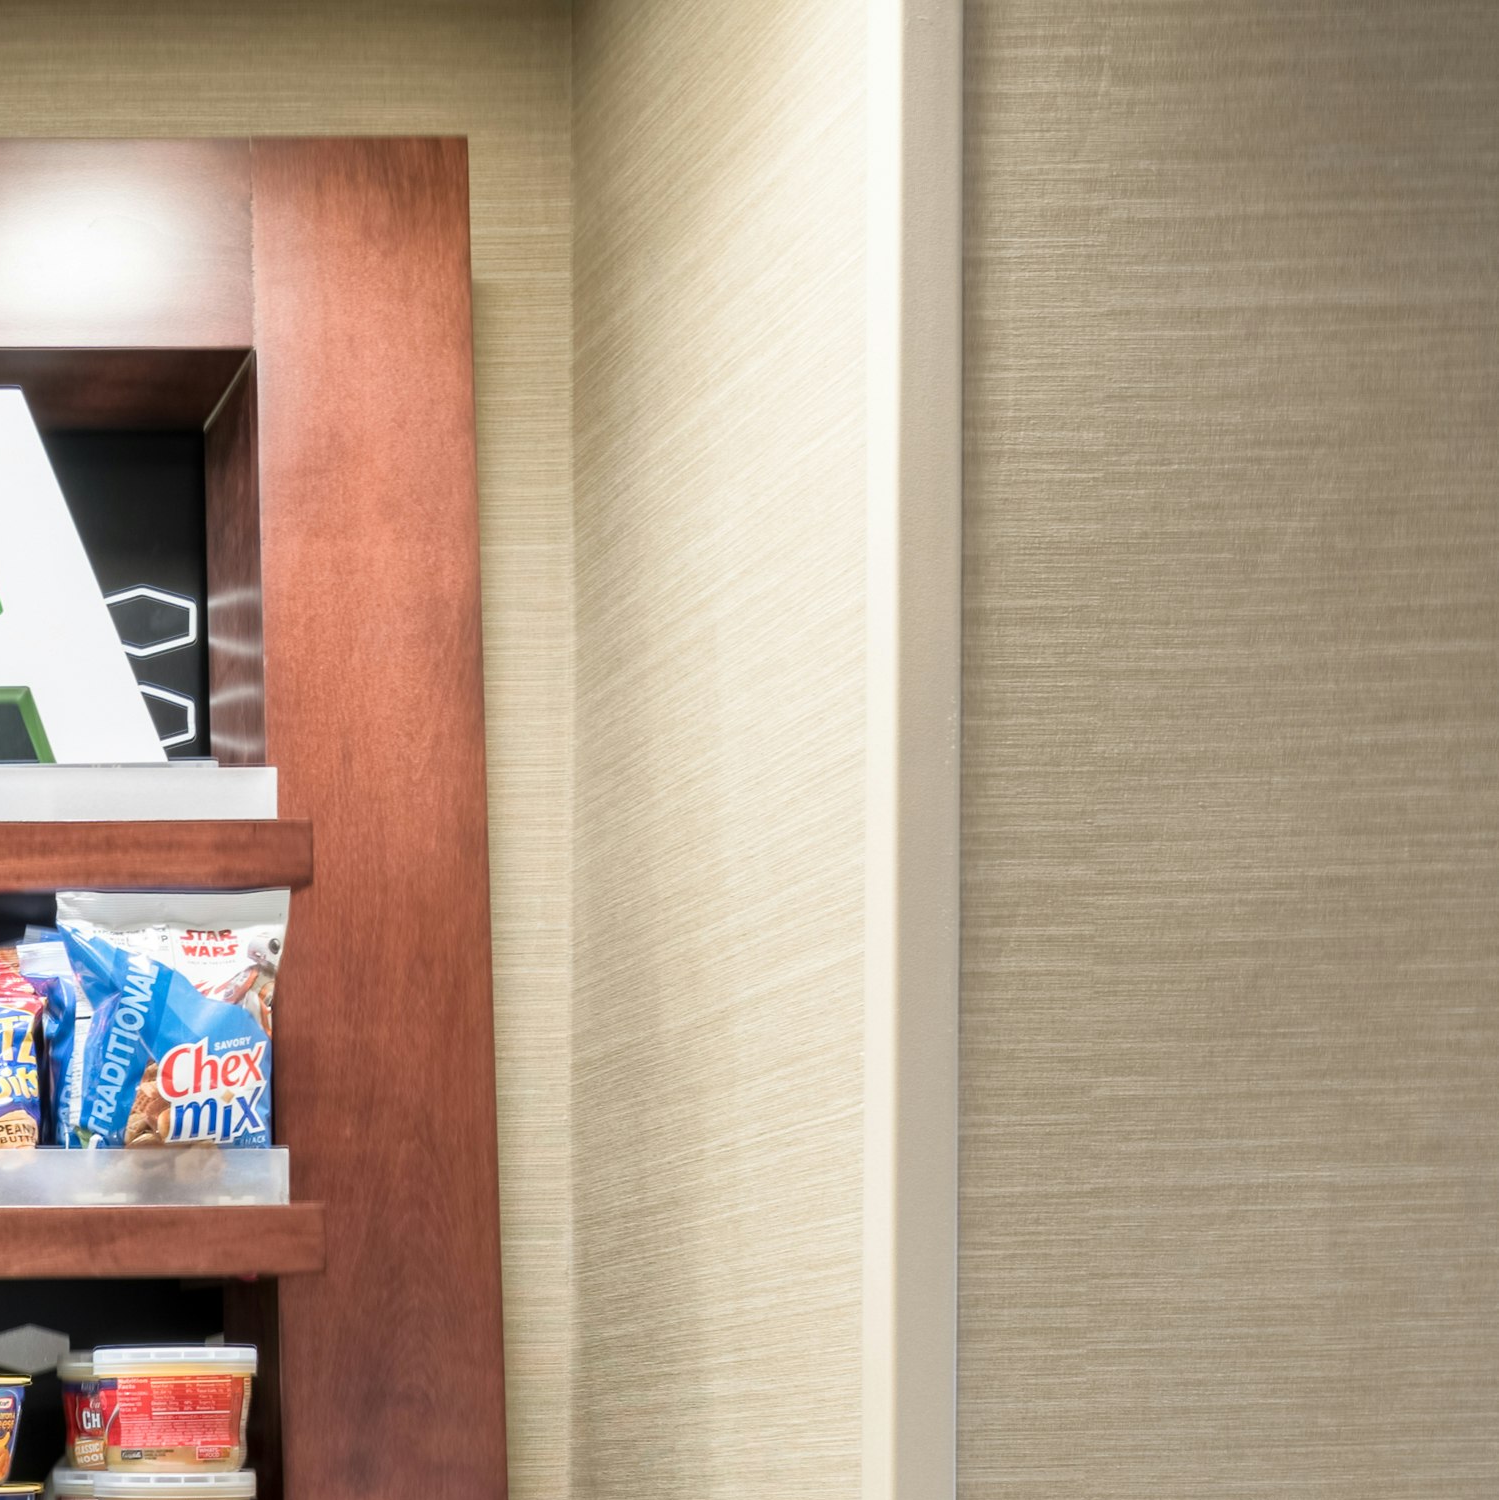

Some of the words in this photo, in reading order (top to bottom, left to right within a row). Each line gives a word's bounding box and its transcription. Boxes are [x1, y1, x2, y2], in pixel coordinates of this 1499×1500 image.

[179, 928, 239, 942] STAR
[181, 944, 240, 958] WARS
[87, 953, 160, 1135] TRADITIONAL
[213, 1036, 252, 1051] SAVORY
[159, 1040, 266, 1100] Chex
[169, 1086, 264, 1143] mix
